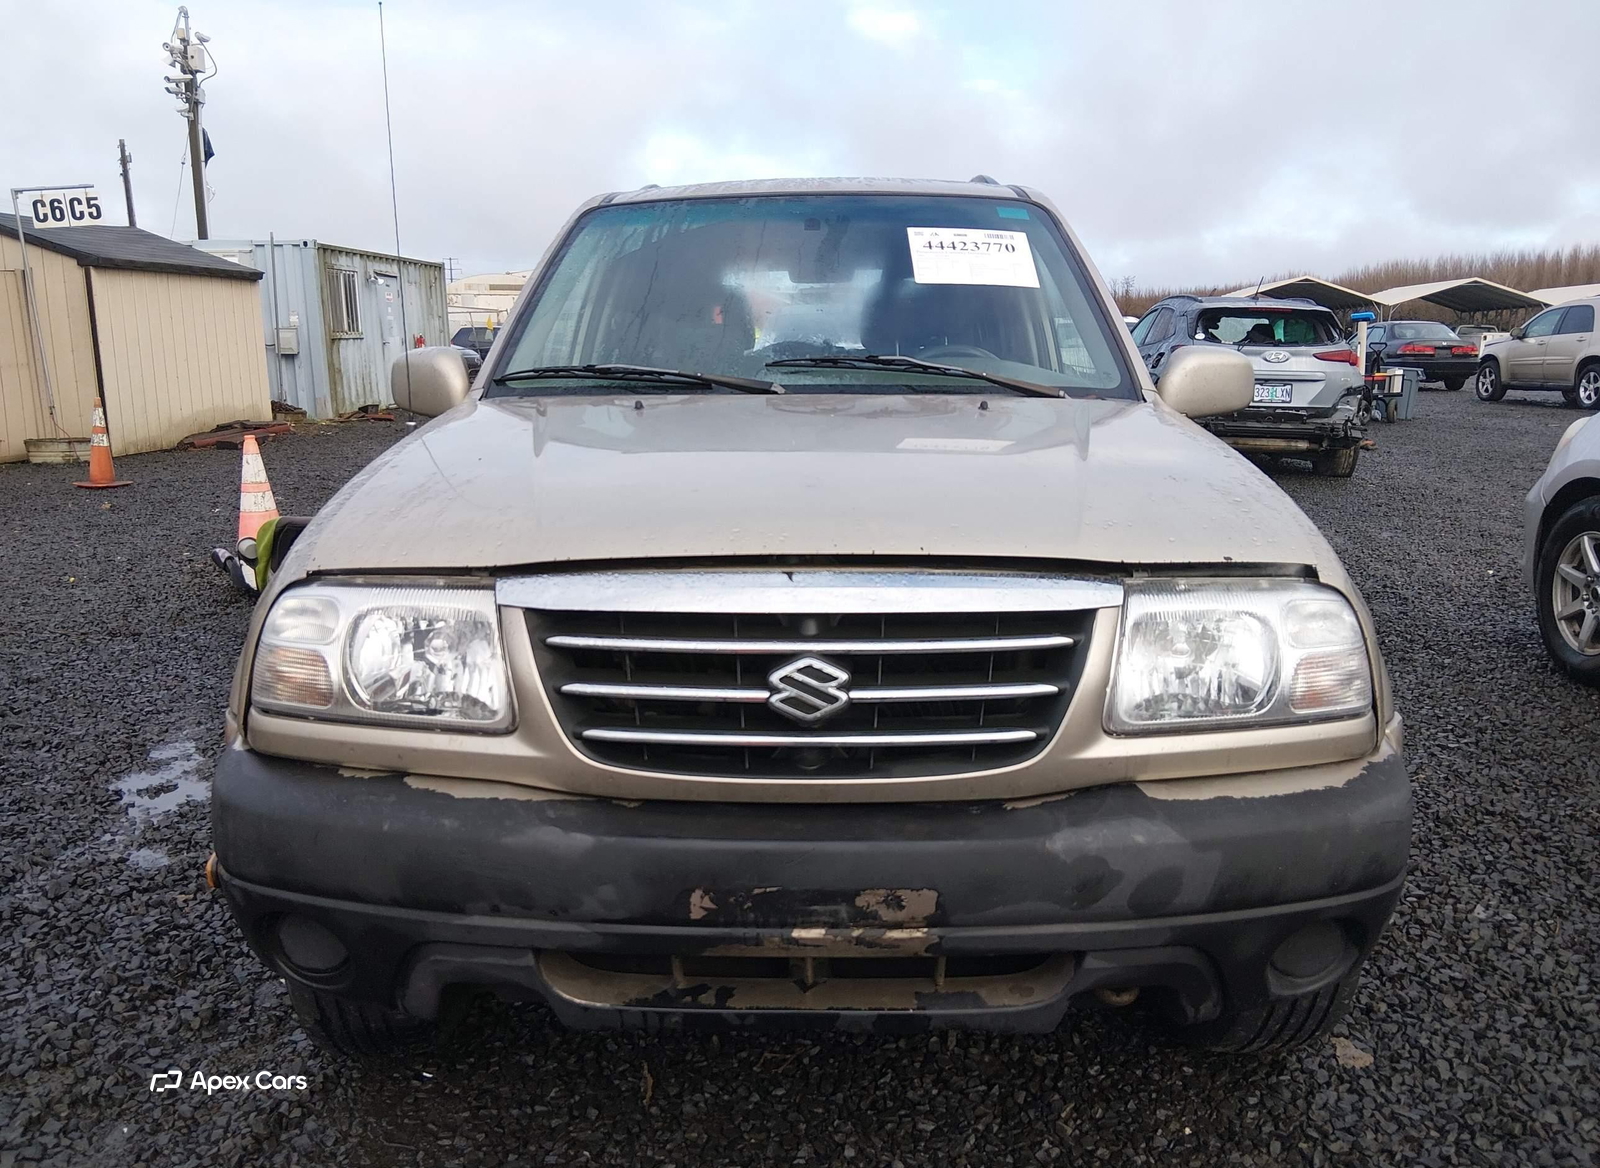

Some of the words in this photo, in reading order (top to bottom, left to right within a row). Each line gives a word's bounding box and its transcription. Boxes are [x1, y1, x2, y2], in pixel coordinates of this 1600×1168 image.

[32, 198, 65, 223] C6
[68, 196, 102, 221] C5
[922, 240, 1016, 253] 44423770
